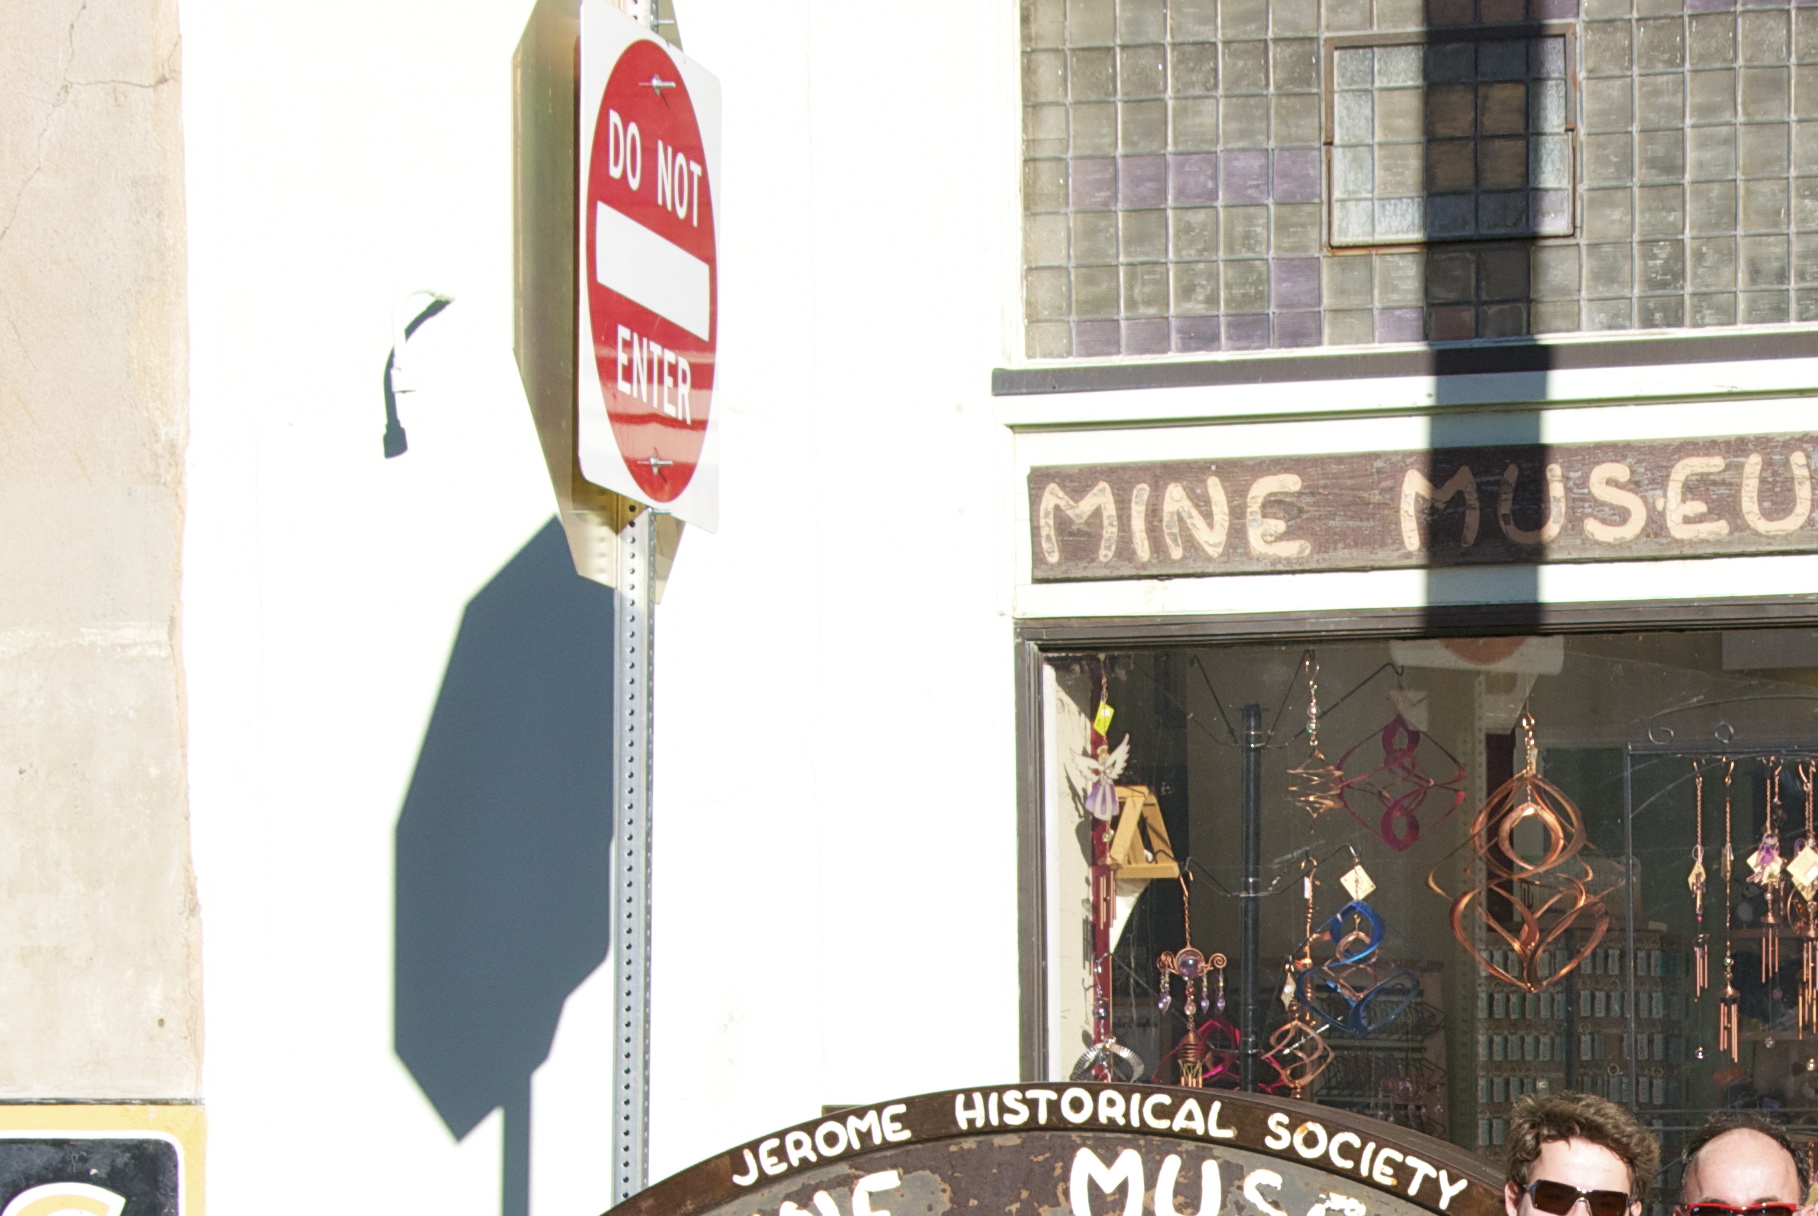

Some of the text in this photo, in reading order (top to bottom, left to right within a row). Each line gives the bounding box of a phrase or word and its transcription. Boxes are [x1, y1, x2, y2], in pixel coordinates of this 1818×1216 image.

[608, 107, 702, 228] DO NOT
[616, 322, 692, 425] ENTER
[1039, 472, 1312, 566] MINE
[732, 1087, 1468, 1211] JEROME HISTORICAL SOCIETY
